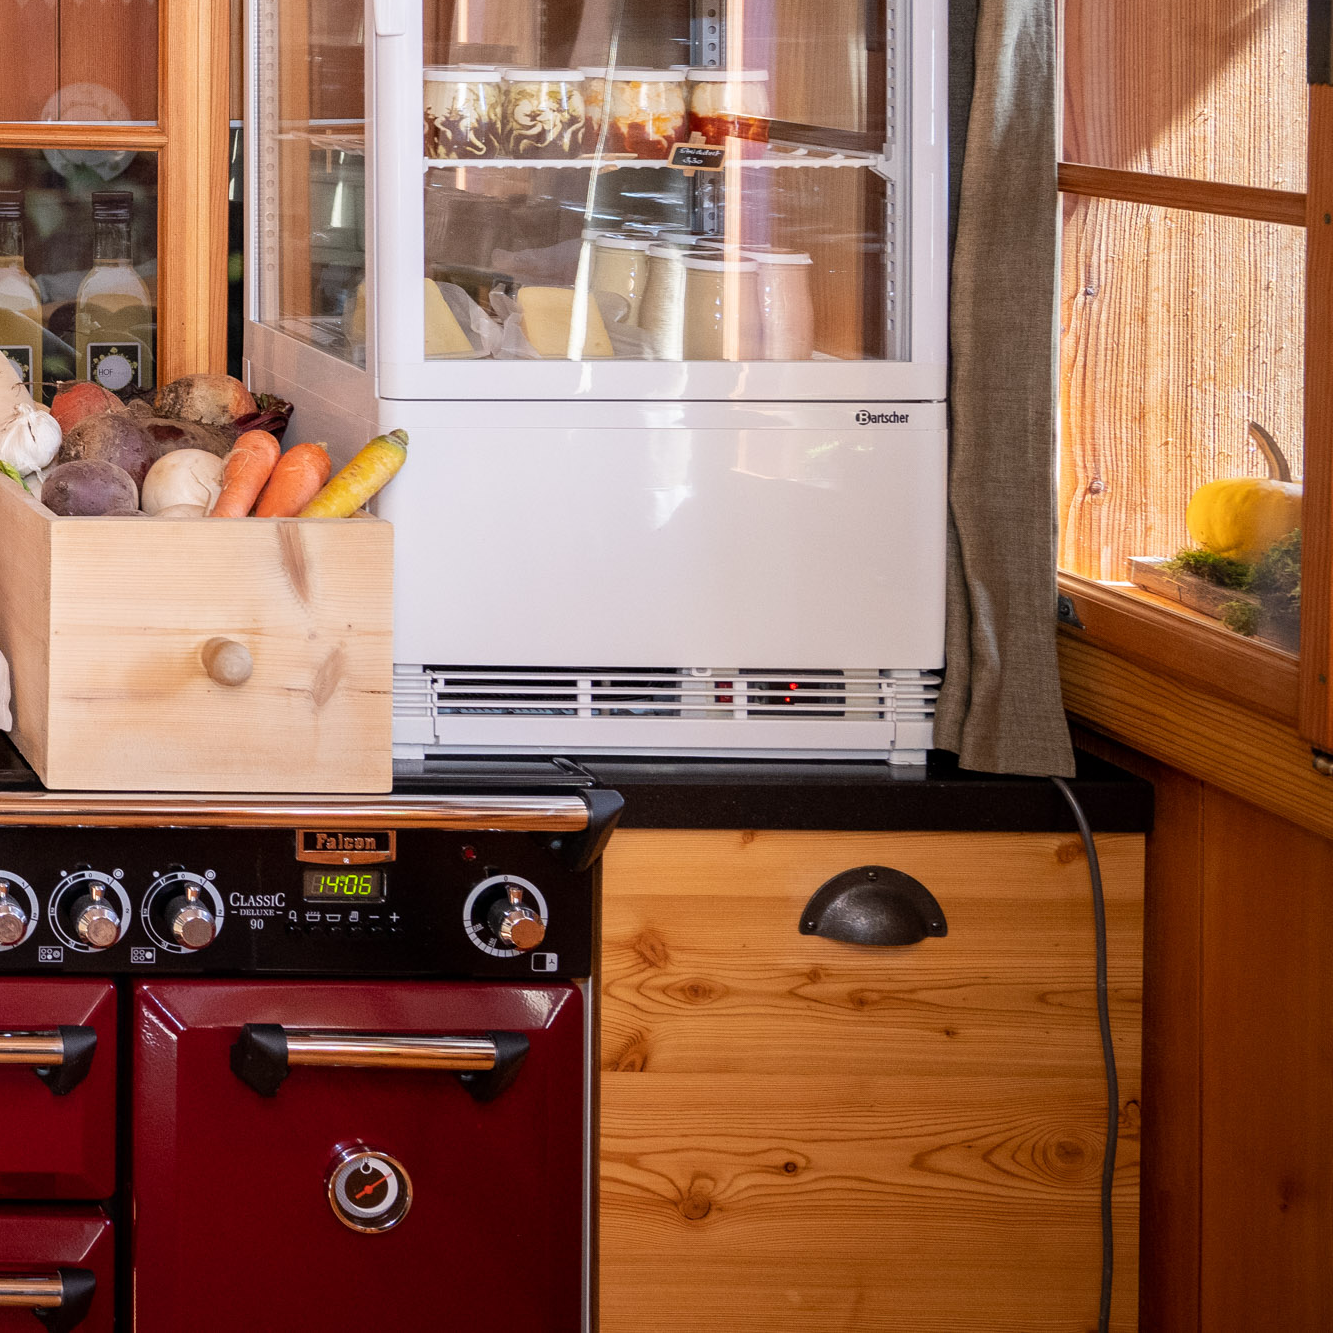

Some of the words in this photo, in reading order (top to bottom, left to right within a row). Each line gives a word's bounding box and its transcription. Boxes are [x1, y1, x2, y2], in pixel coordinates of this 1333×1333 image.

[98, 368, 114, 376] HOF
[855, 409, 910, 426] Bartscher
[315, 833, 377, 850] Falcon
[319, 874, 373, 895] 14:06
[229, 891, 286, 907] CLASSIC
[239, 908, 275, 916] DELUXE
[249, 918, 264, 930] 90
